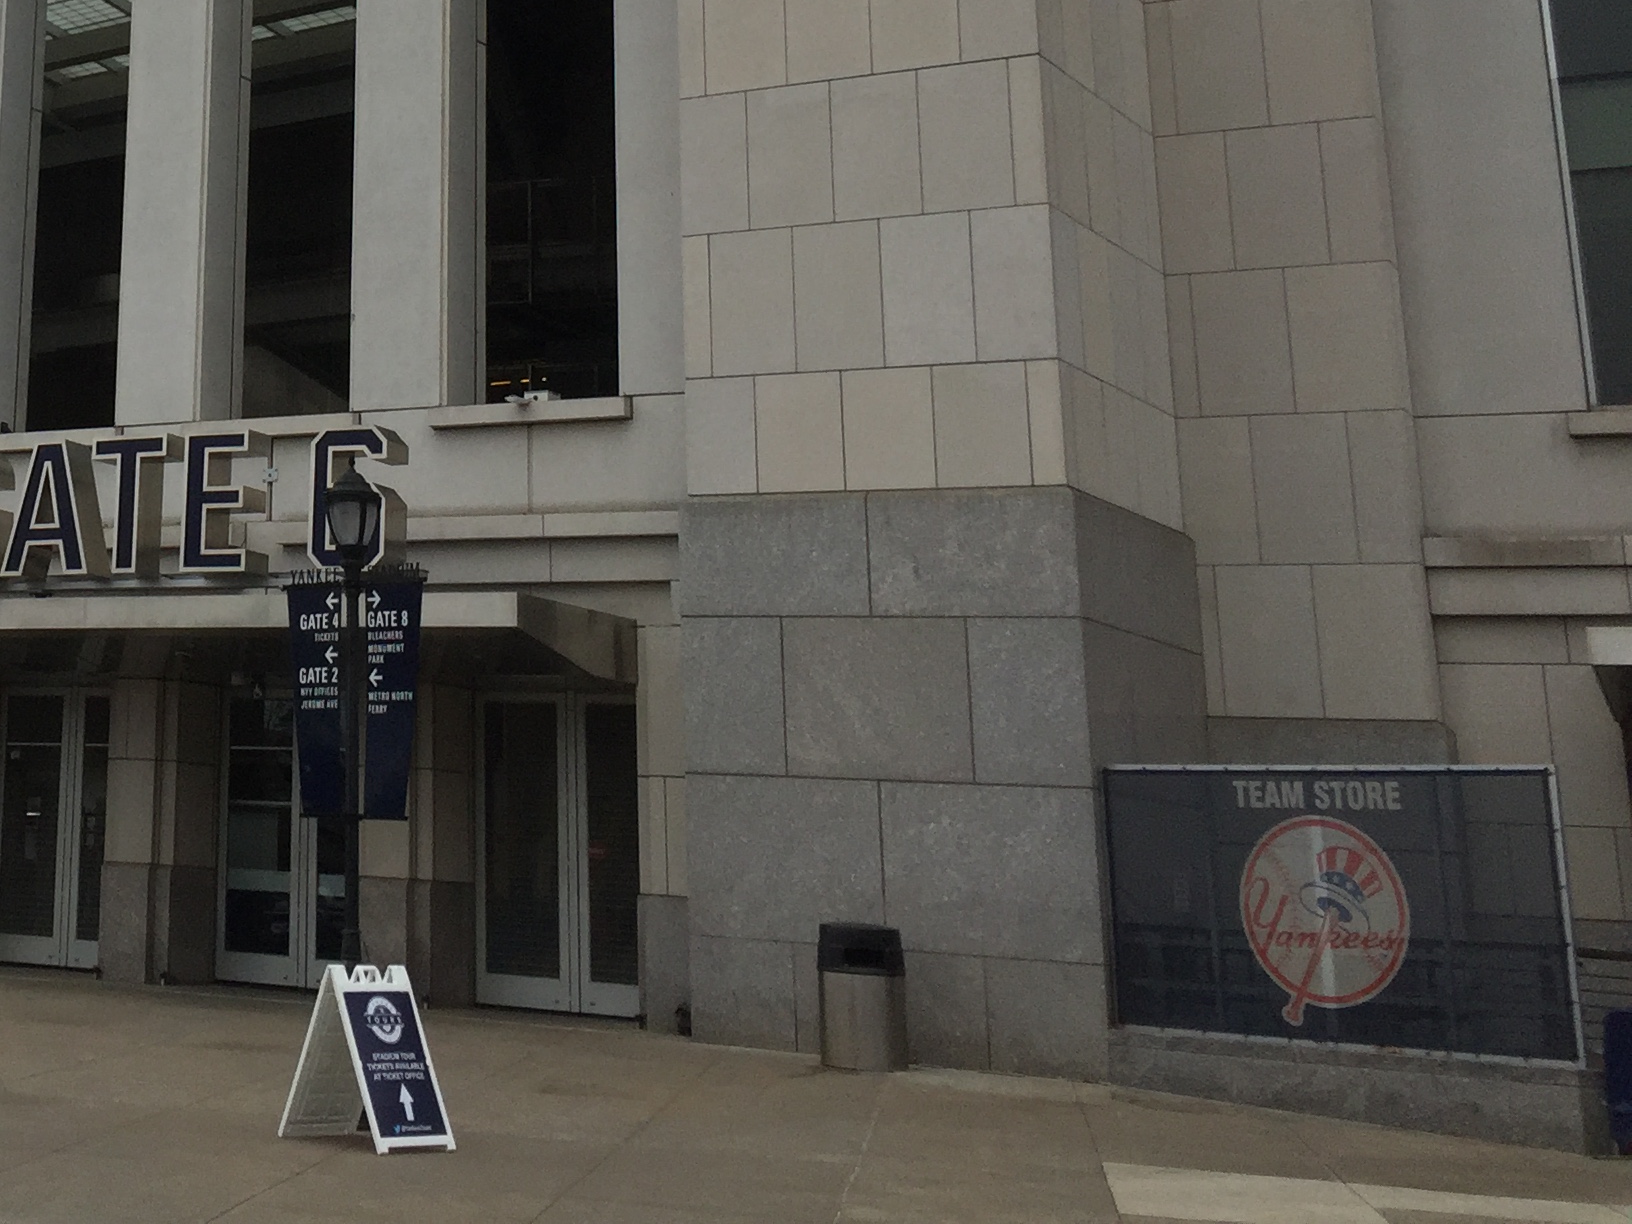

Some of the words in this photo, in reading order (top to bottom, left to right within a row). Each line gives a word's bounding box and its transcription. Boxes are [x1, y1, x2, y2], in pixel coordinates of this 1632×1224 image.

[307, 424, 390, 574] 6
[300, 613, 328, 630] GATE
[332, 612, 339, 628] 4
[367, 611, 397, 627] GATE
[401, 610, 408, 626] 8
[367, 630, 403, 641] BLEACHERS
[367, 643, 404, 653] MONUMENT
[368, 654, 384, 664] PARK
[299, 667, 328, 684] GATE
[331, 667, 338, 683] 2
[1232, 780, 1305, 809] TEAM
[1313, 781, 1402, 810] STORE
